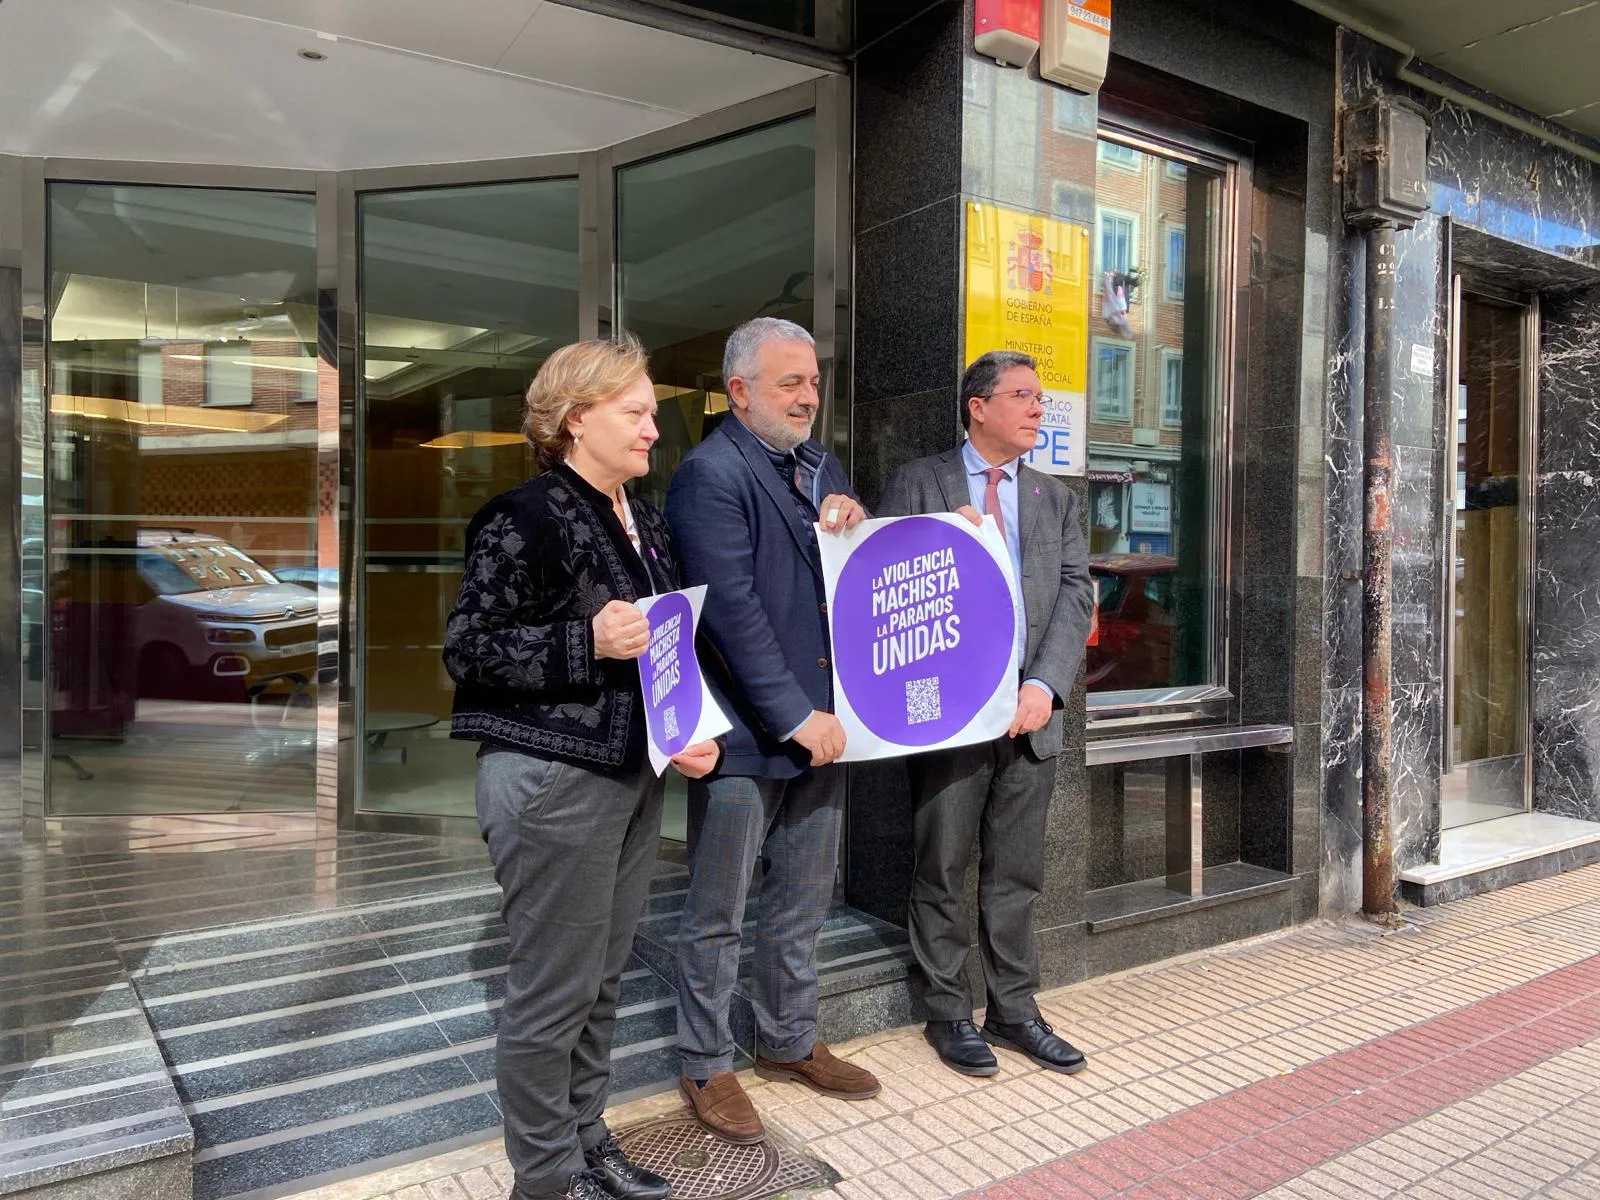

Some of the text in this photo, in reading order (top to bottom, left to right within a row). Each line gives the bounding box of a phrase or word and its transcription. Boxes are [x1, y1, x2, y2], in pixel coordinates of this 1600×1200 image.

[1006, 297, 1053, 314] GOBIERNO
[1006, 310, 1053, 328] DE ESPAÑA
[1005, 339, 1053, 355] MINISTERIO
[1042, 371, 1072, 385] SOCIAL
[1041, 412, 1072, 426] STATAL
[1045, 400, 1072, 412] LICO
[1029, 429, 1070, 466] PE
[872, 547, 955, 591] LA VIOLENCIA
[872, 566, 960, 617] MACHISTA
[653, 611, 682, 641] VIOLENCIA
[876, 594, 954, 638] LA PARAMOS
[649, 625, 680, 666] MACHISTA
[655, 644, 678, 677] PARAMOS
[872, 614, 961, 676] UNIDAS
[651, 659, 681, 709] UNIDAS
